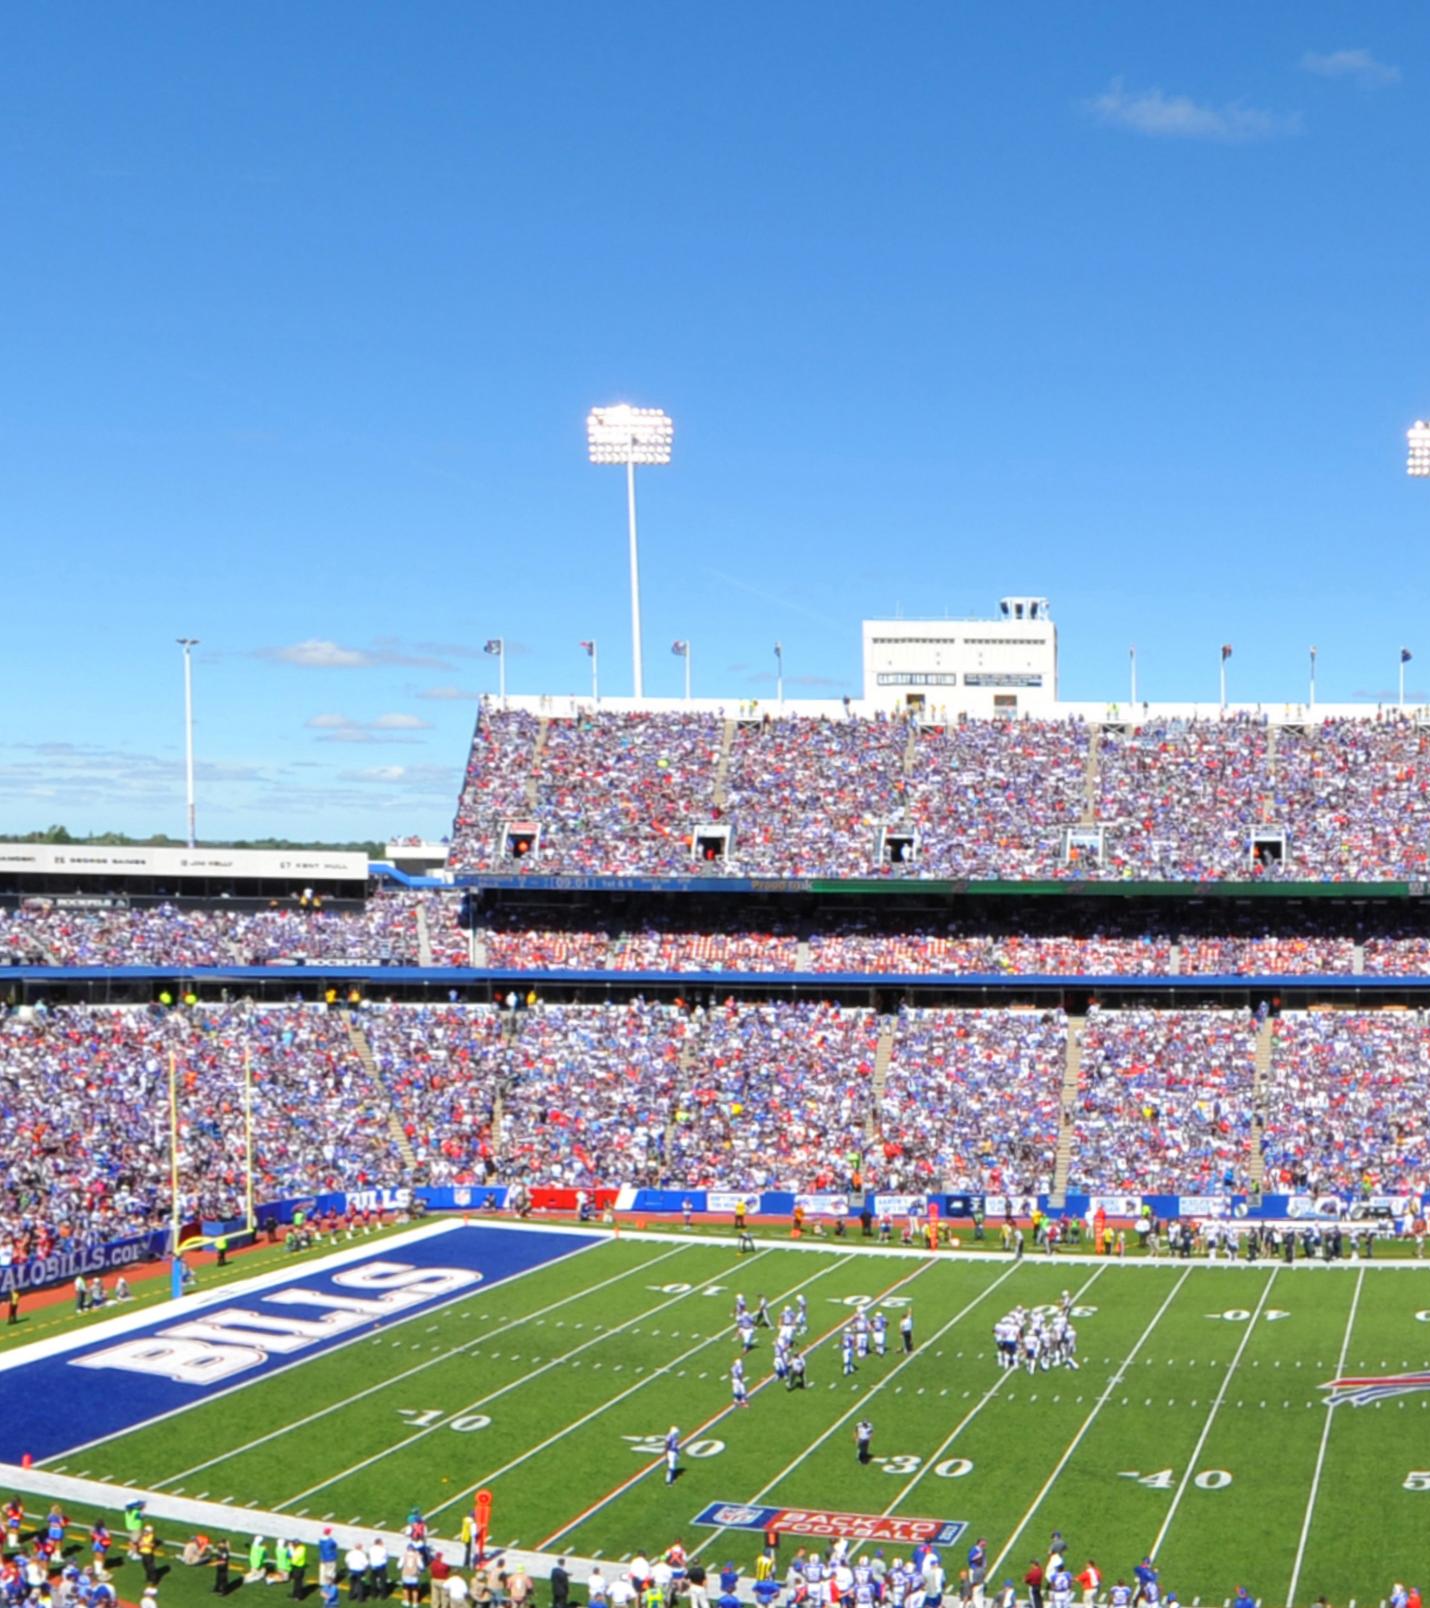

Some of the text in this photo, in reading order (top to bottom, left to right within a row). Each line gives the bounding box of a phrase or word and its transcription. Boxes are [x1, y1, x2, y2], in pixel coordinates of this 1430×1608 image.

[346, 1188, 411, 1211] BILLS
[67, 1261, 484, 1386] BILLS
[405, 1409, 492, 1432] 10
[882, 1455, 974, 1478] 30
[1137, 1469, 1233, 1489] 40
[771, 1521, 927, 1542] FOOTBALL
[783, 1511, 937, 1533] BACK TO
